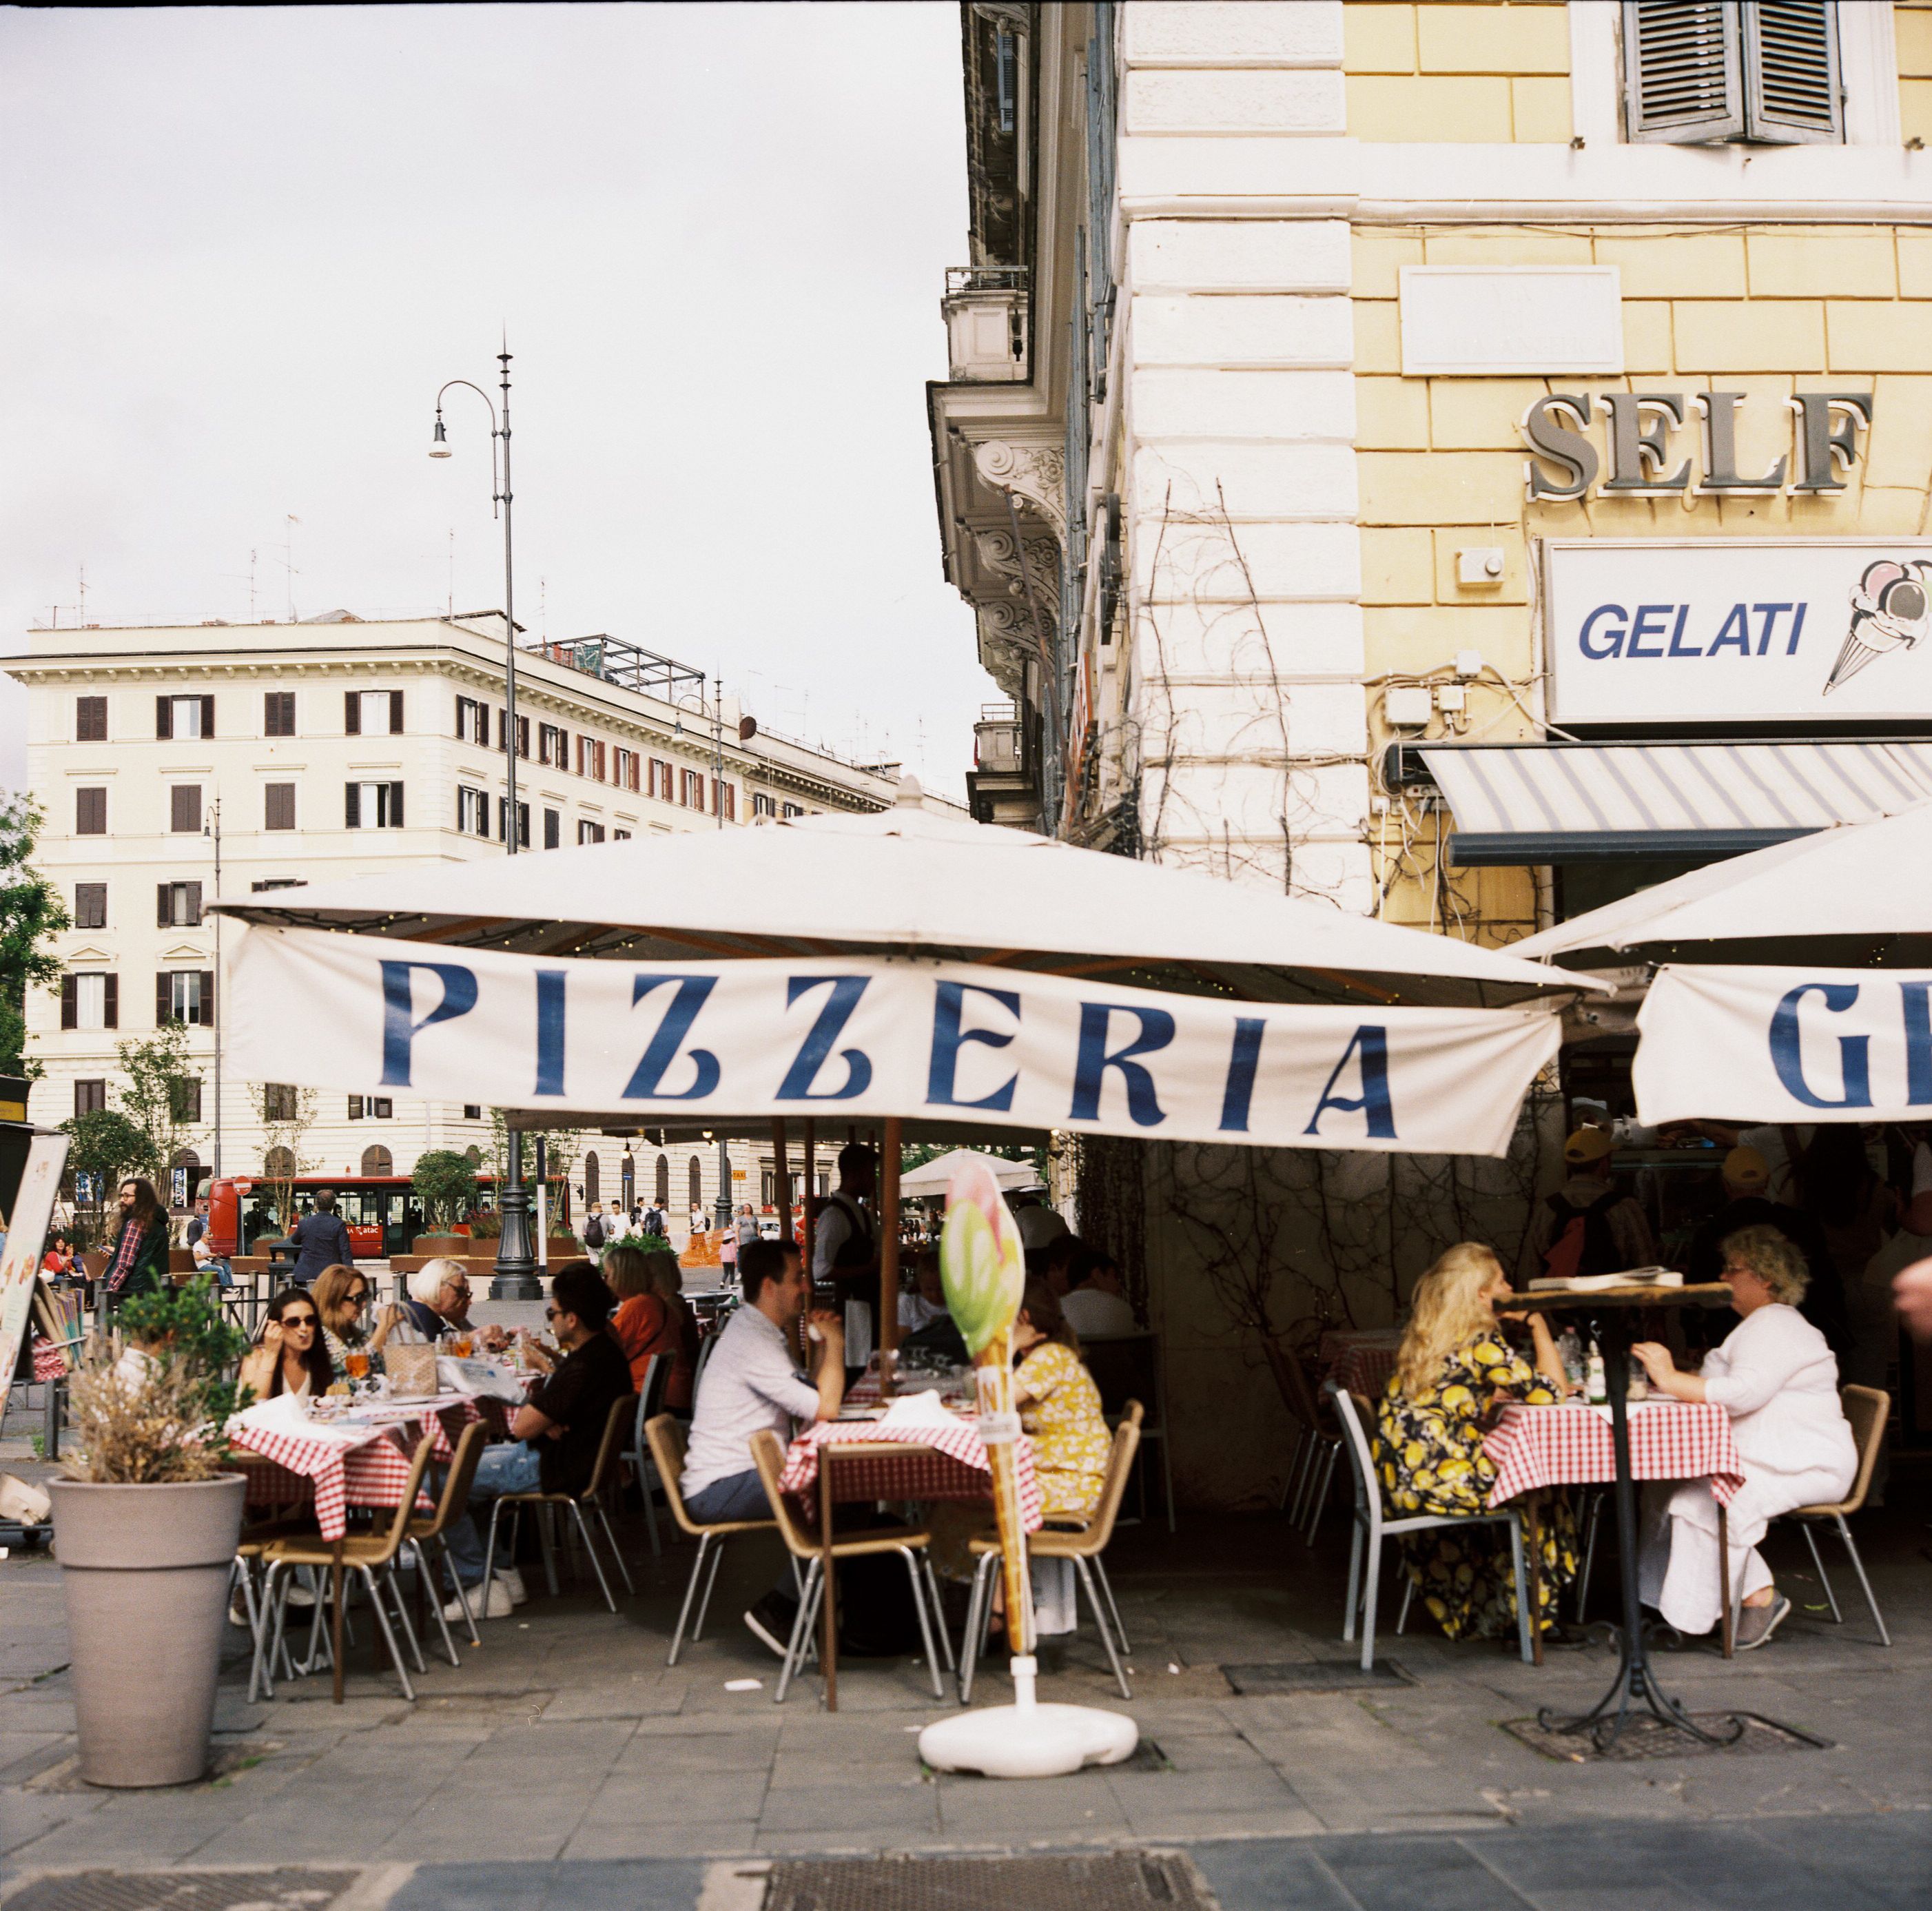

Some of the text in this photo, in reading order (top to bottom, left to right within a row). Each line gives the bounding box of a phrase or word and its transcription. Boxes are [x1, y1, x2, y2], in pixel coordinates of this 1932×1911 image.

[1521, 392, 1873, 502] SELF
[1579, 602, 1809, 660] GELATI
[378, 959, 1399, 1139] PIZZERIA
